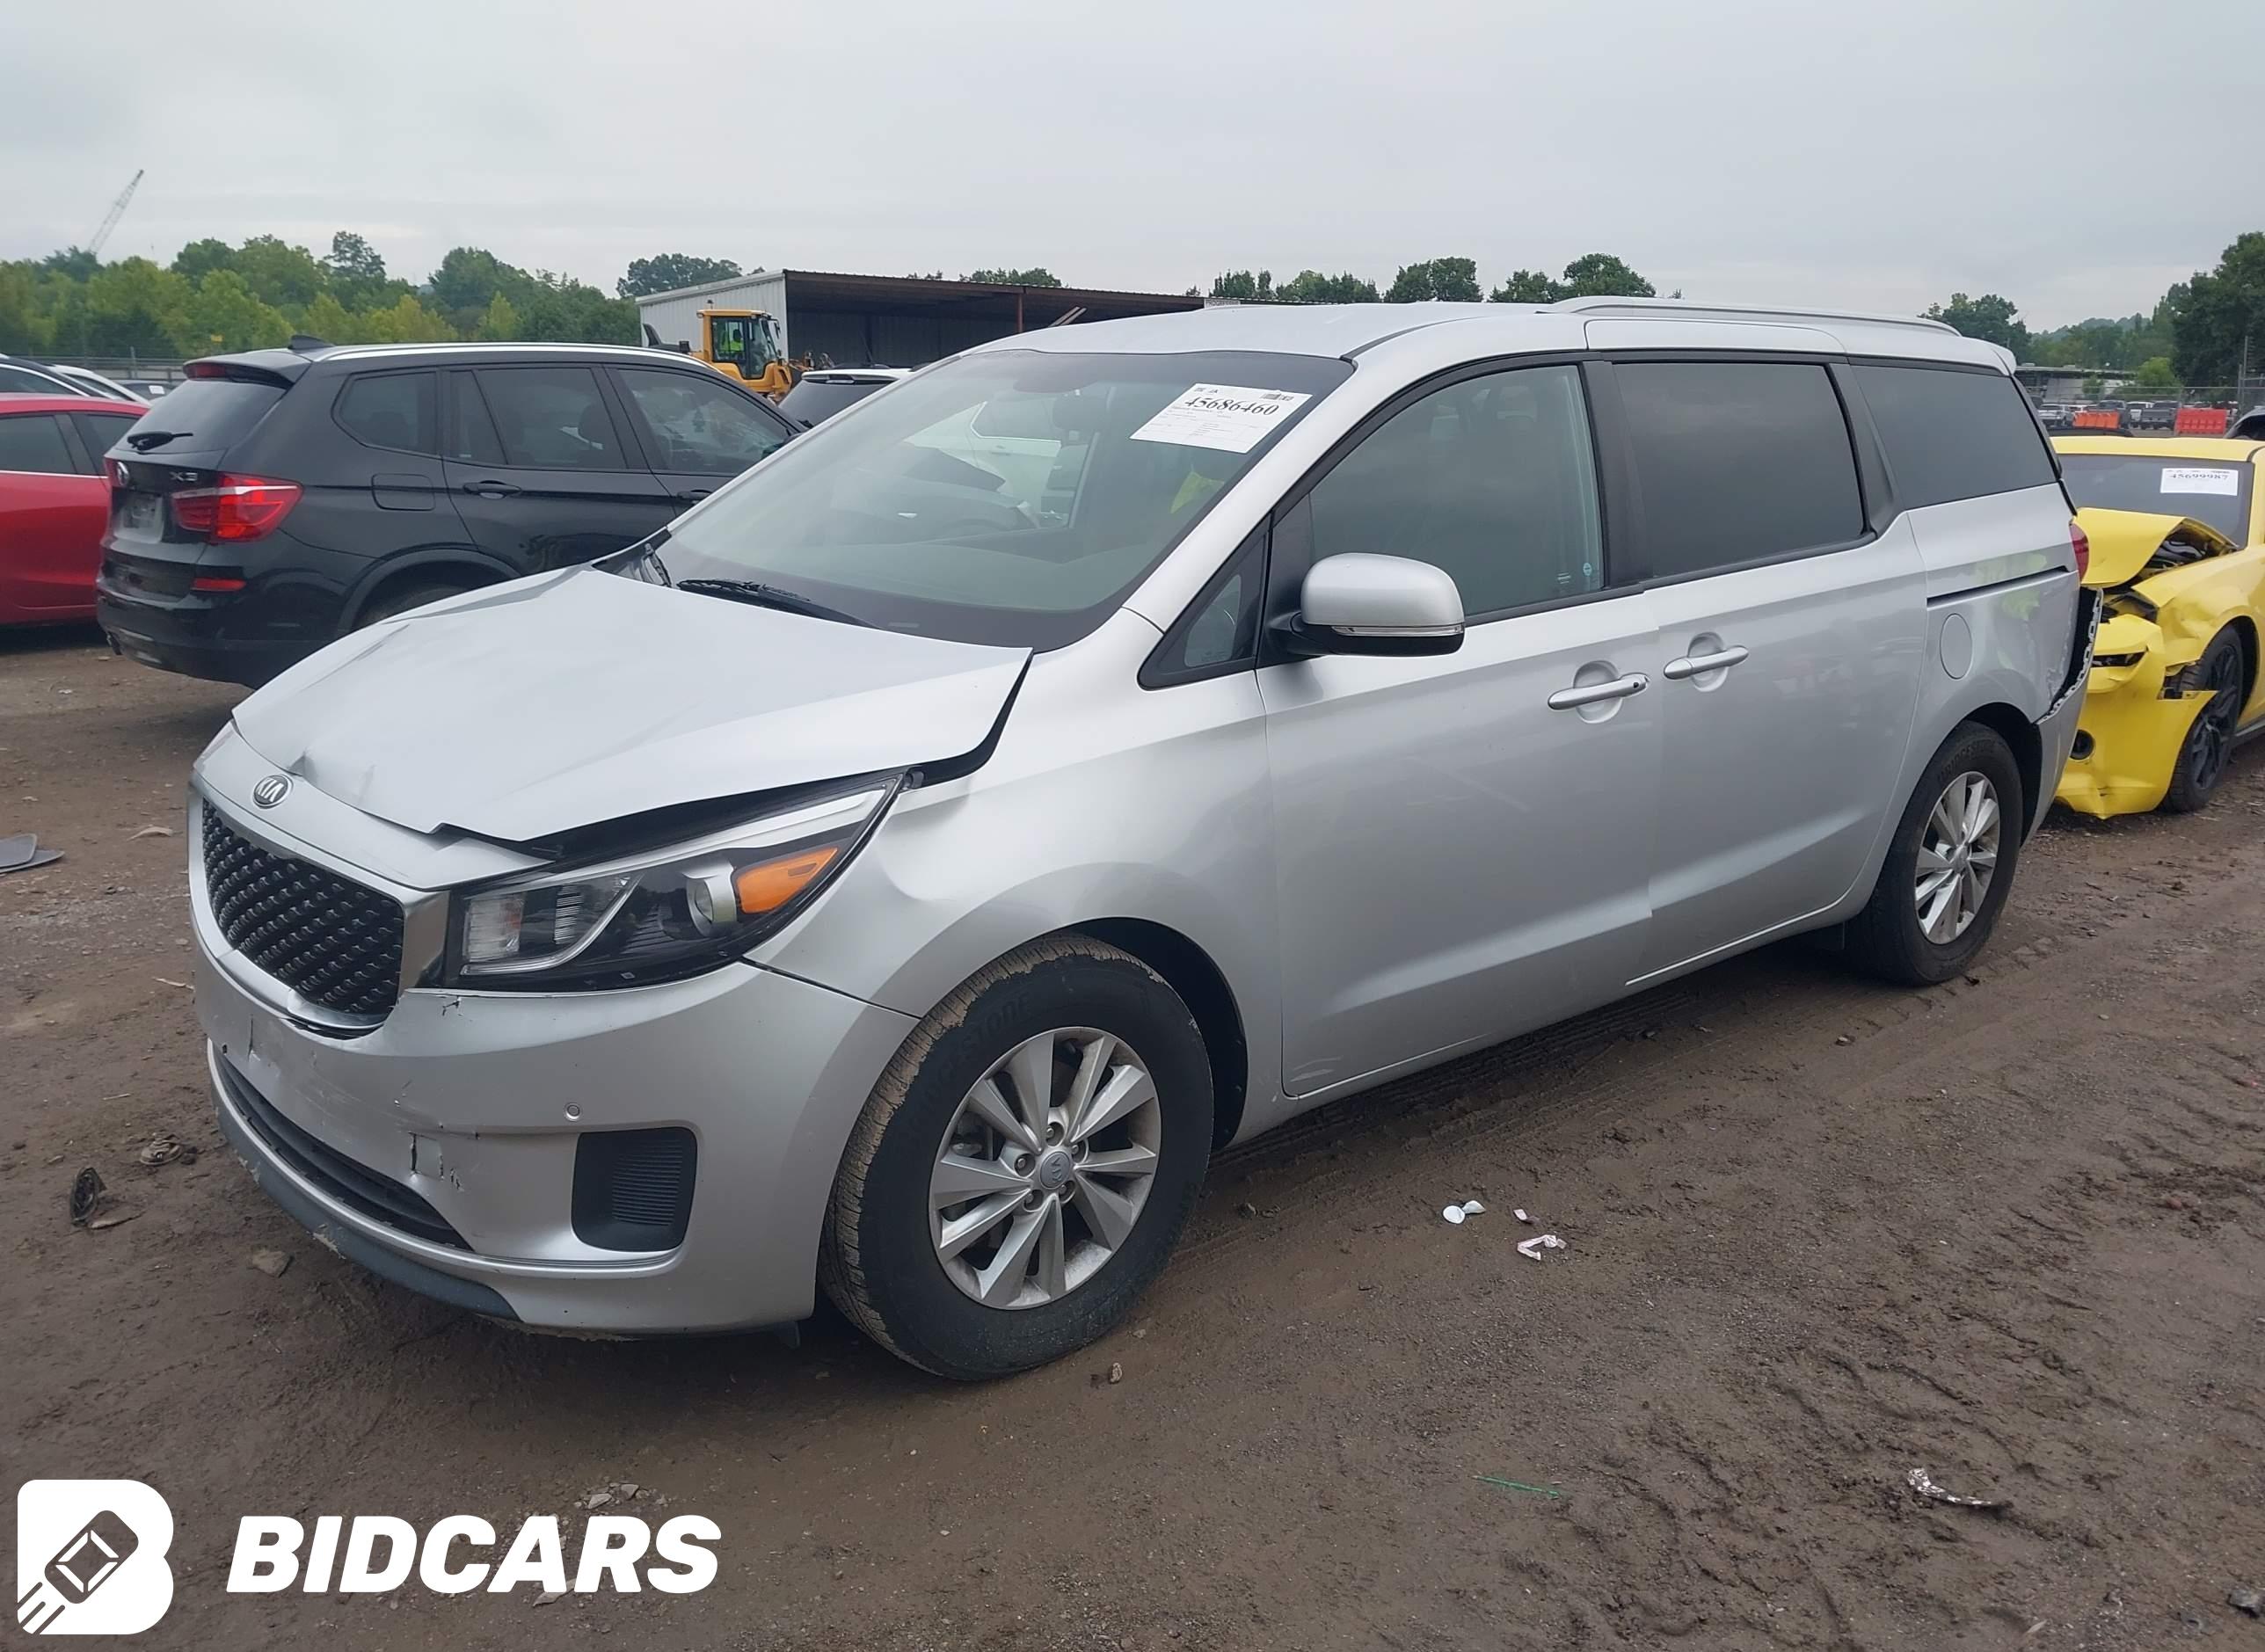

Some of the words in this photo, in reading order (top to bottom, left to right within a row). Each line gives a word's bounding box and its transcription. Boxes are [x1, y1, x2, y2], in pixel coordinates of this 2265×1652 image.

[1184, 397, 1279, 416] 45686460
[169, 471, 198, 482] X3
[256, 777, 284, 803] KIA
